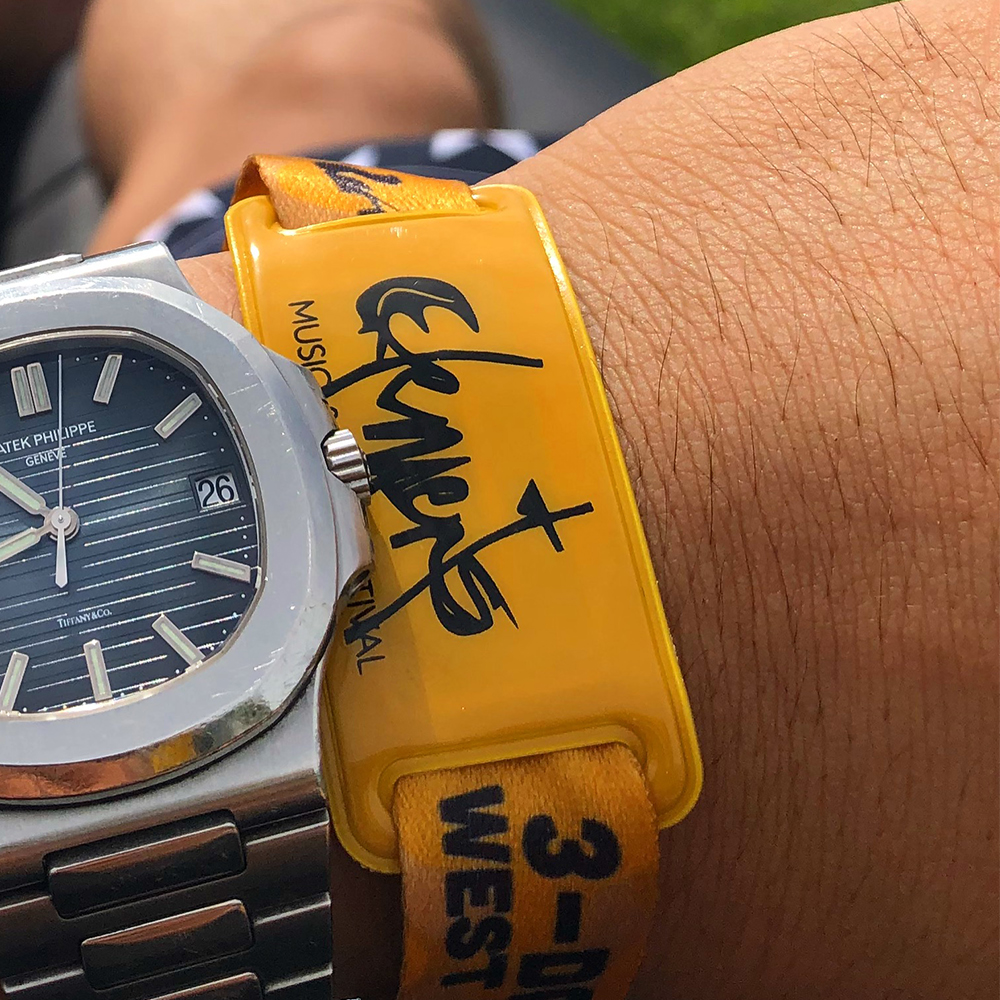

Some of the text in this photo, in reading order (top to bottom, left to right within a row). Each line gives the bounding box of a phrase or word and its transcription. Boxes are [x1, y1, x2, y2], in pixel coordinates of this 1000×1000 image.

[33, 420, 97, 447] PHILIPPE
[198, 474, 235, 507] 26
[439, 784, 514, 990] WEST
